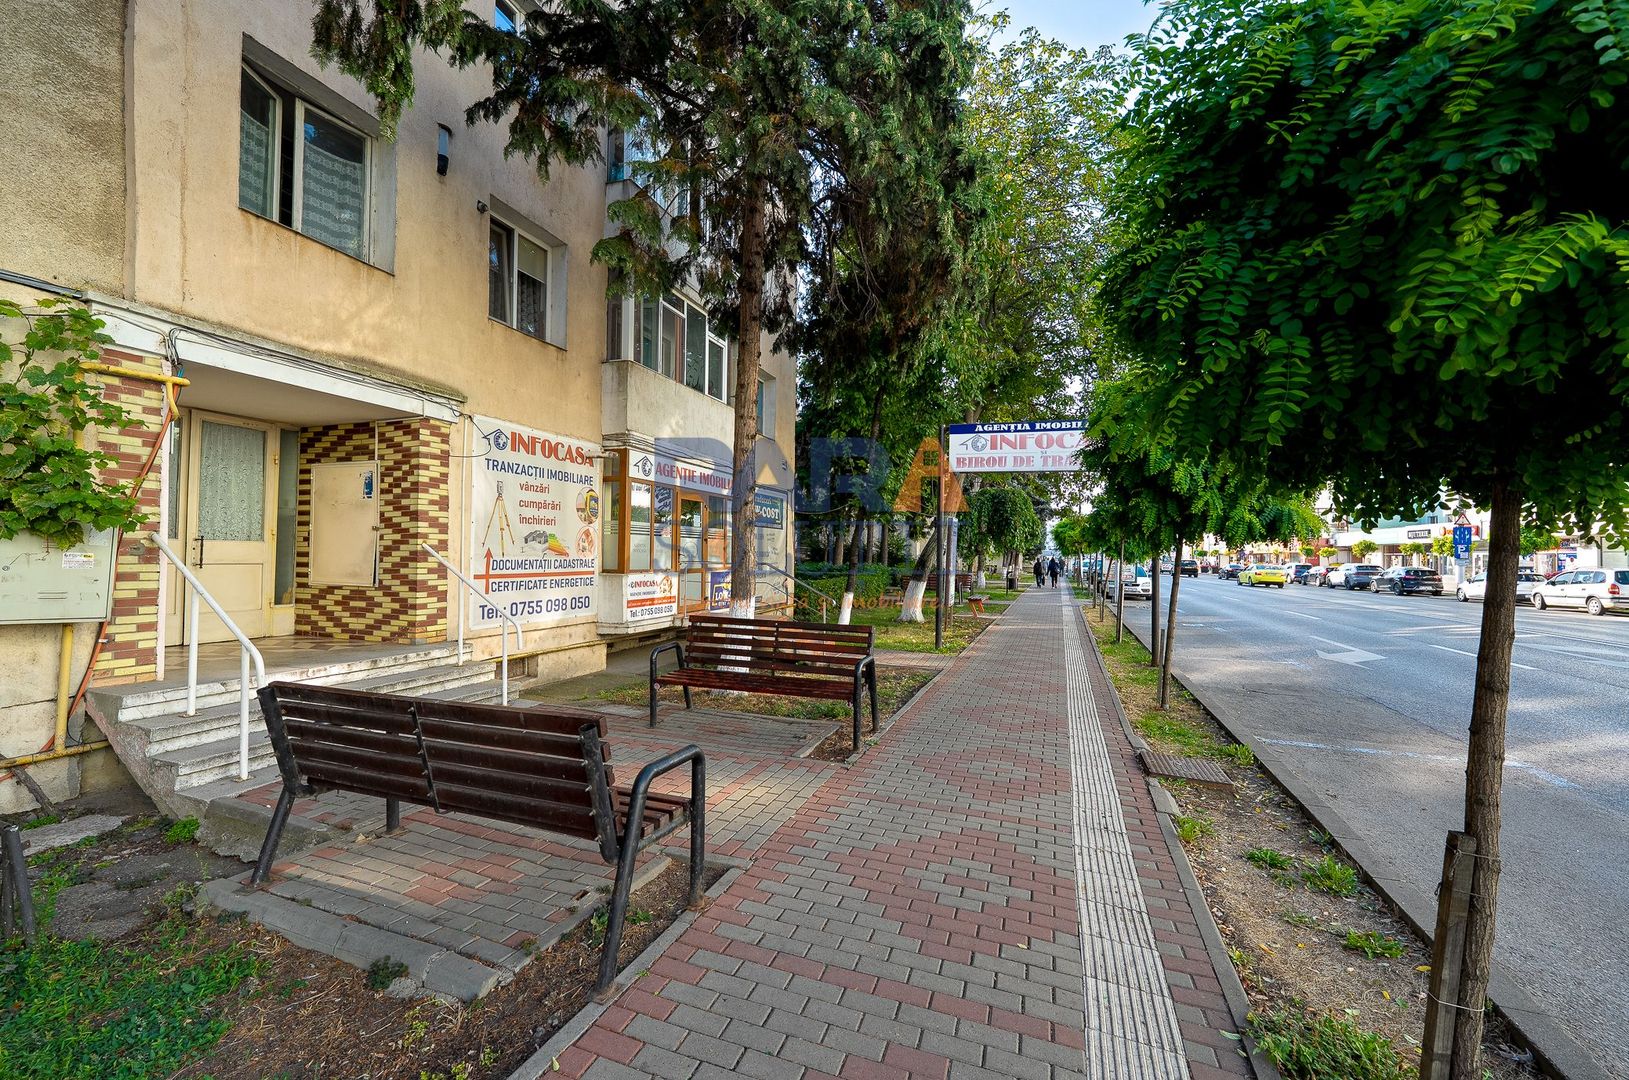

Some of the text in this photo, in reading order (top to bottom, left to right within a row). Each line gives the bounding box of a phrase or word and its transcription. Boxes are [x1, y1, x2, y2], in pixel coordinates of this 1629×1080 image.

[974, 422, 1031, 433] AGENȚIA
[510, 431, 595, 468] INFOCASA
[955, 455, 1008, 469] BIROU
[1012, 454, 1035, 468] DE
[484, 457, 594, 487] TRANZACȚII IMOBILIARE
[655, 461, 697, 485] AGENȚIE
[519, 480, 550, 495] vânzări
[518, 498, 562, 512] cumpărări
[518, 513, 557, 527] închirieri
[491, 557, 595, 573] DOCUMENTAȚII CADASTRALE
[490, 576, 594, 593] CERTIFICATE ENERGETICE
[510, 599, 543, 617] 0755
[545, 596, 568, 613] 098
[570, 595, 590, 610] 050
